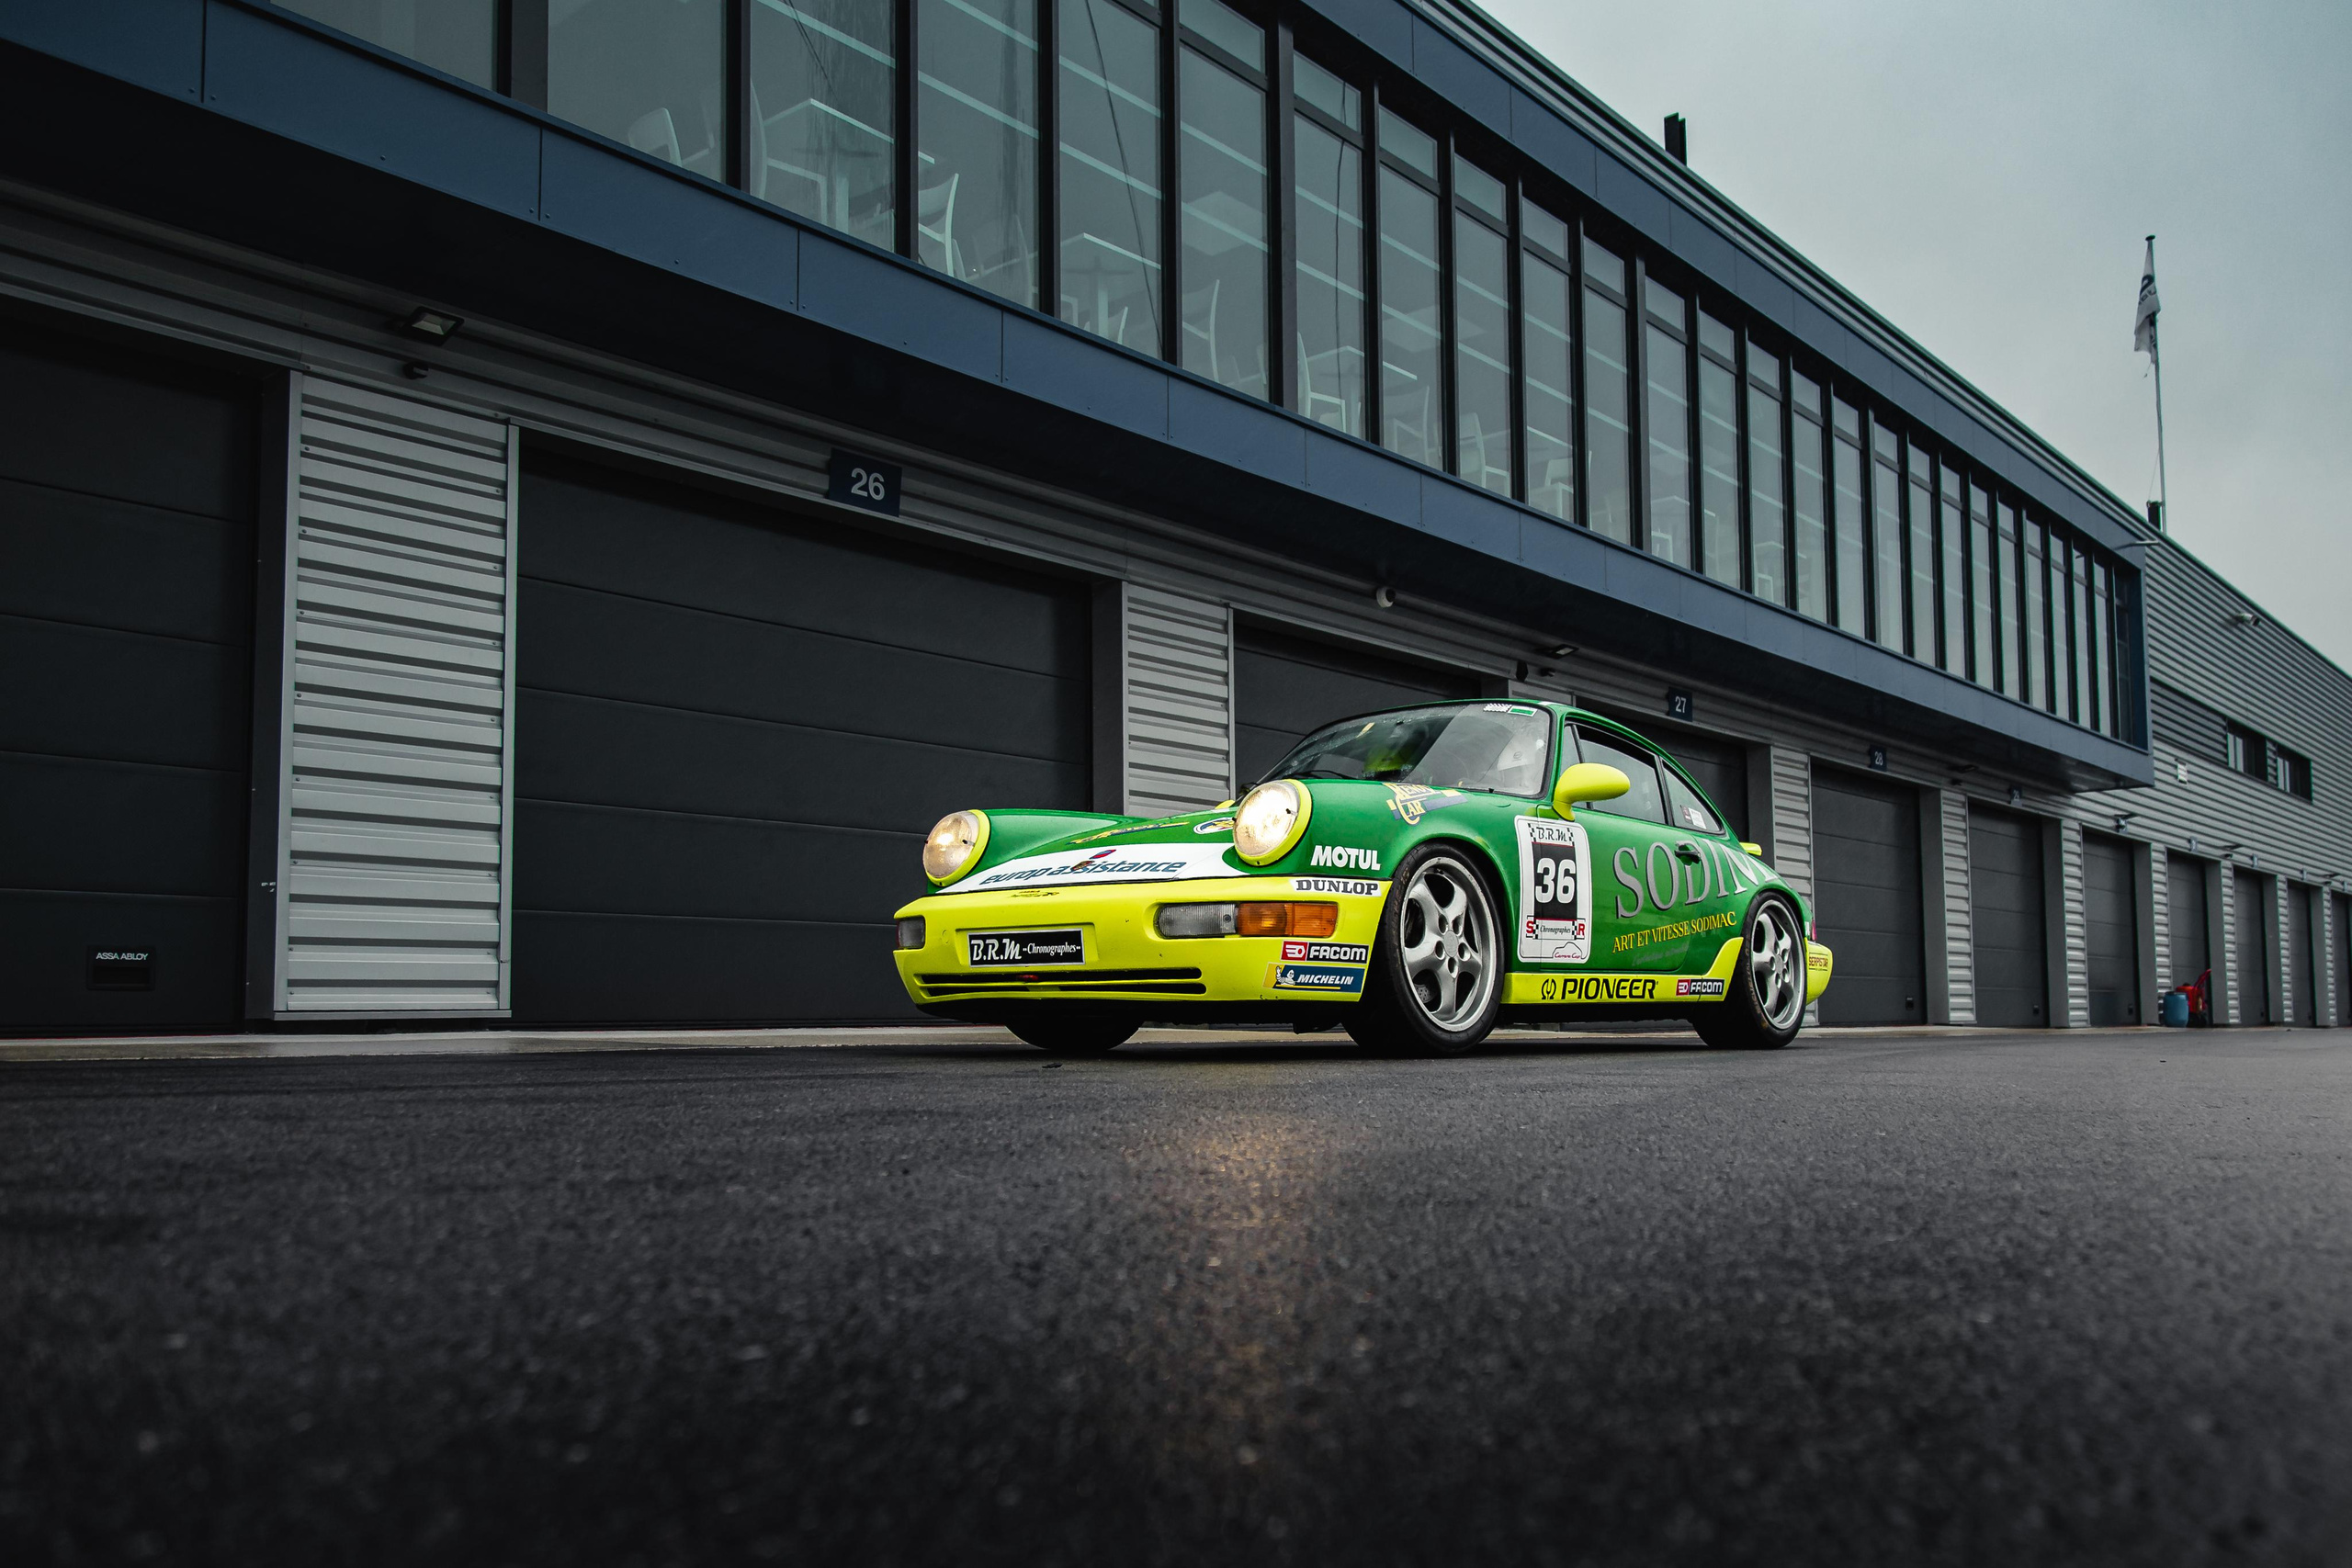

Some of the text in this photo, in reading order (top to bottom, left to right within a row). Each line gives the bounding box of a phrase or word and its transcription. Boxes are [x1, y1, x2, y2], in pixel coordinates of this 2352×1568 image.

[851, 468, 885, 501] 26
[1675, 695, 1687, 714] 27
[1536, 826, 1567, 842] B.R.M
[1310, 844, 1381, 871] MOTUL
[1295, 879, 1379, 896] DUNLOP
[1534, 857, 1577, 904] 36
[1611, 933, 1634, 953] ART
[1636, 930, 1650, 947] ET
[1651, 922, 1691, 943] VITESSE
[1690, 911, 1737, 934] SODIMAC
[96, 952, 149, 961] ASSA ABLOY
[970, 938, 1022, 961] B.R.M
[1309, 945, 1367, 961] FACOM
[1296, 974, 1354, 985] MICHELIN
[1561, 977, 1656, 1000] PIONEER
[1690, 982, 1724, 994] FACOM
